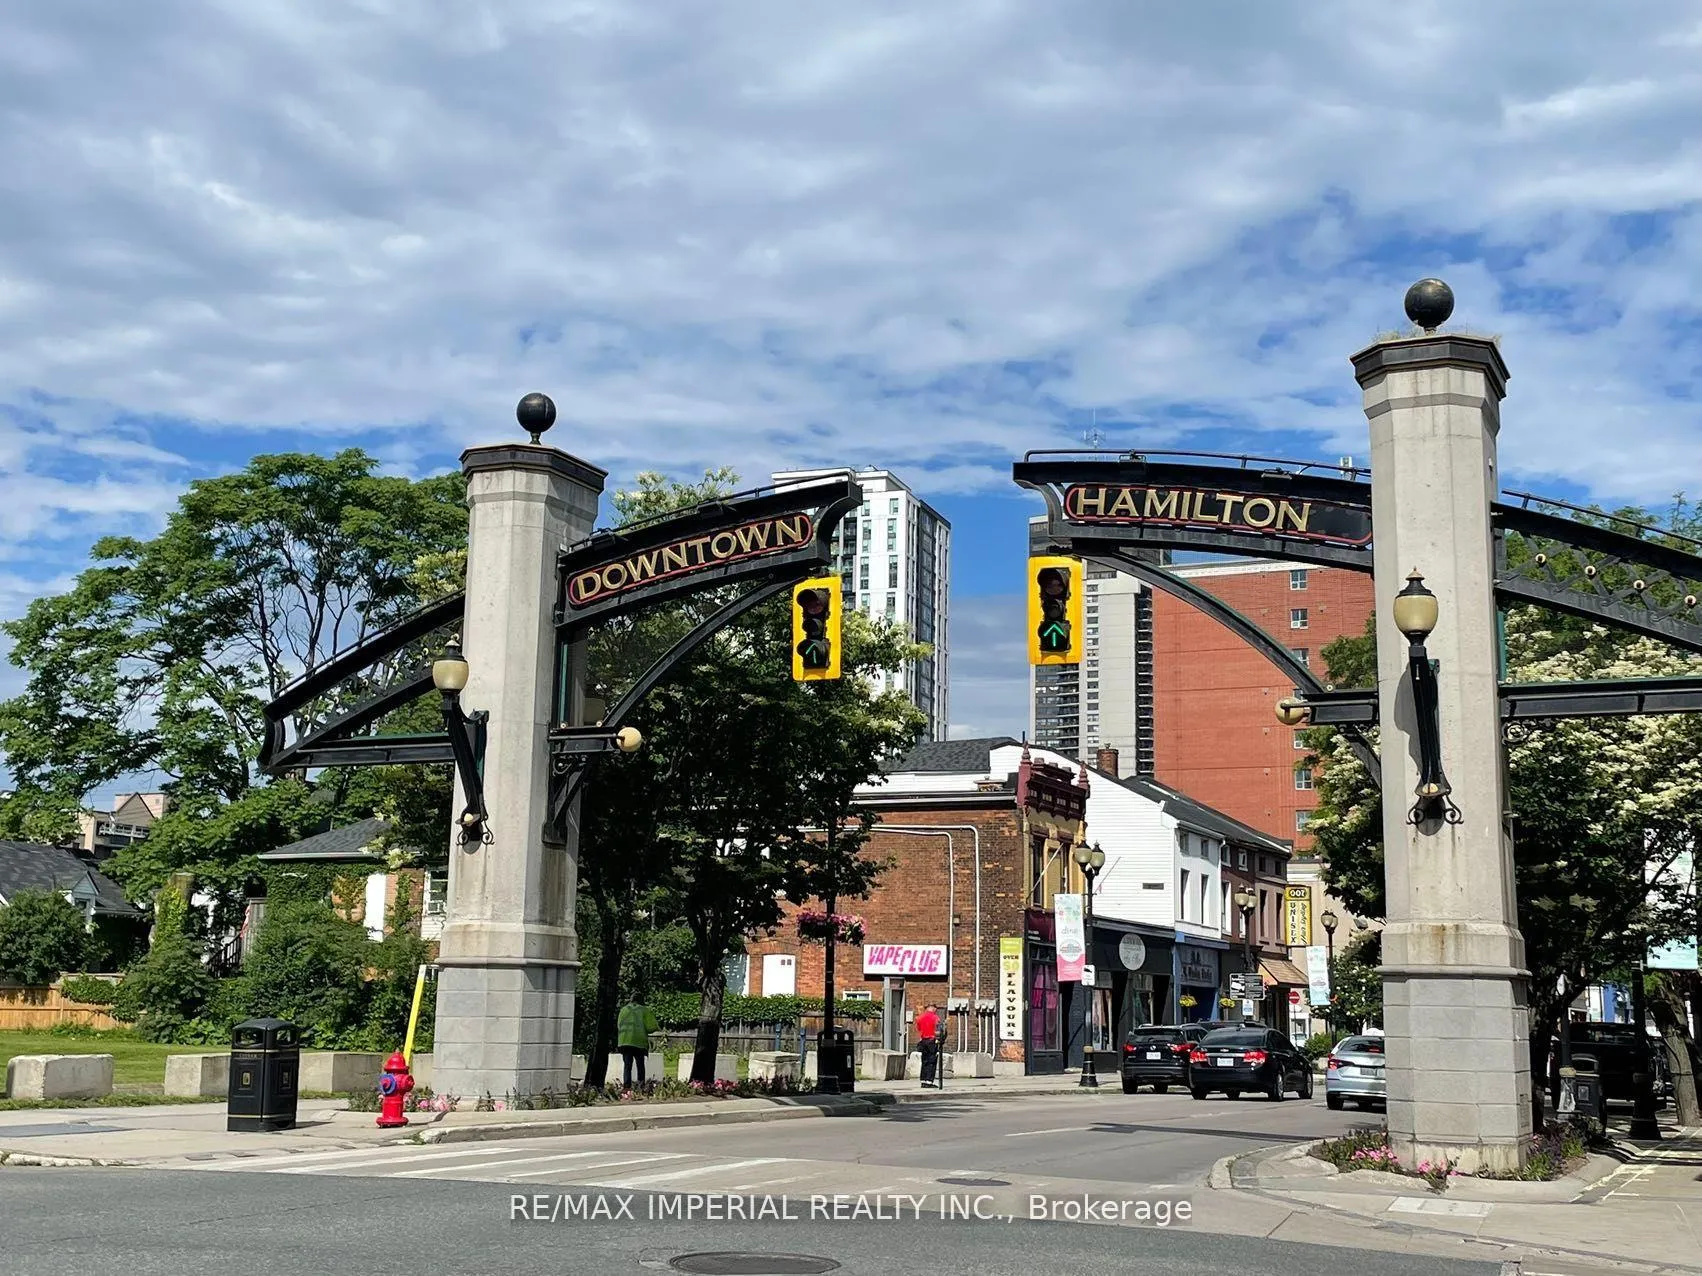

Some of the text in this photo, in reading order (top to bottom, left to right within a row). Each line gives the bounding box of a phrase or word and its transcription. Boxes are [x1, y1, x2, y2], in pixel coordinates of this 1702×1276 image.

[1076, 487, 1311, 532] HAMILTON
[577, 515, 804, 600] DOWNTOWN
[868, 946, 942, 972] VAPE CLUB
[1006, 972, 1016, 1037] FLAVOURS
